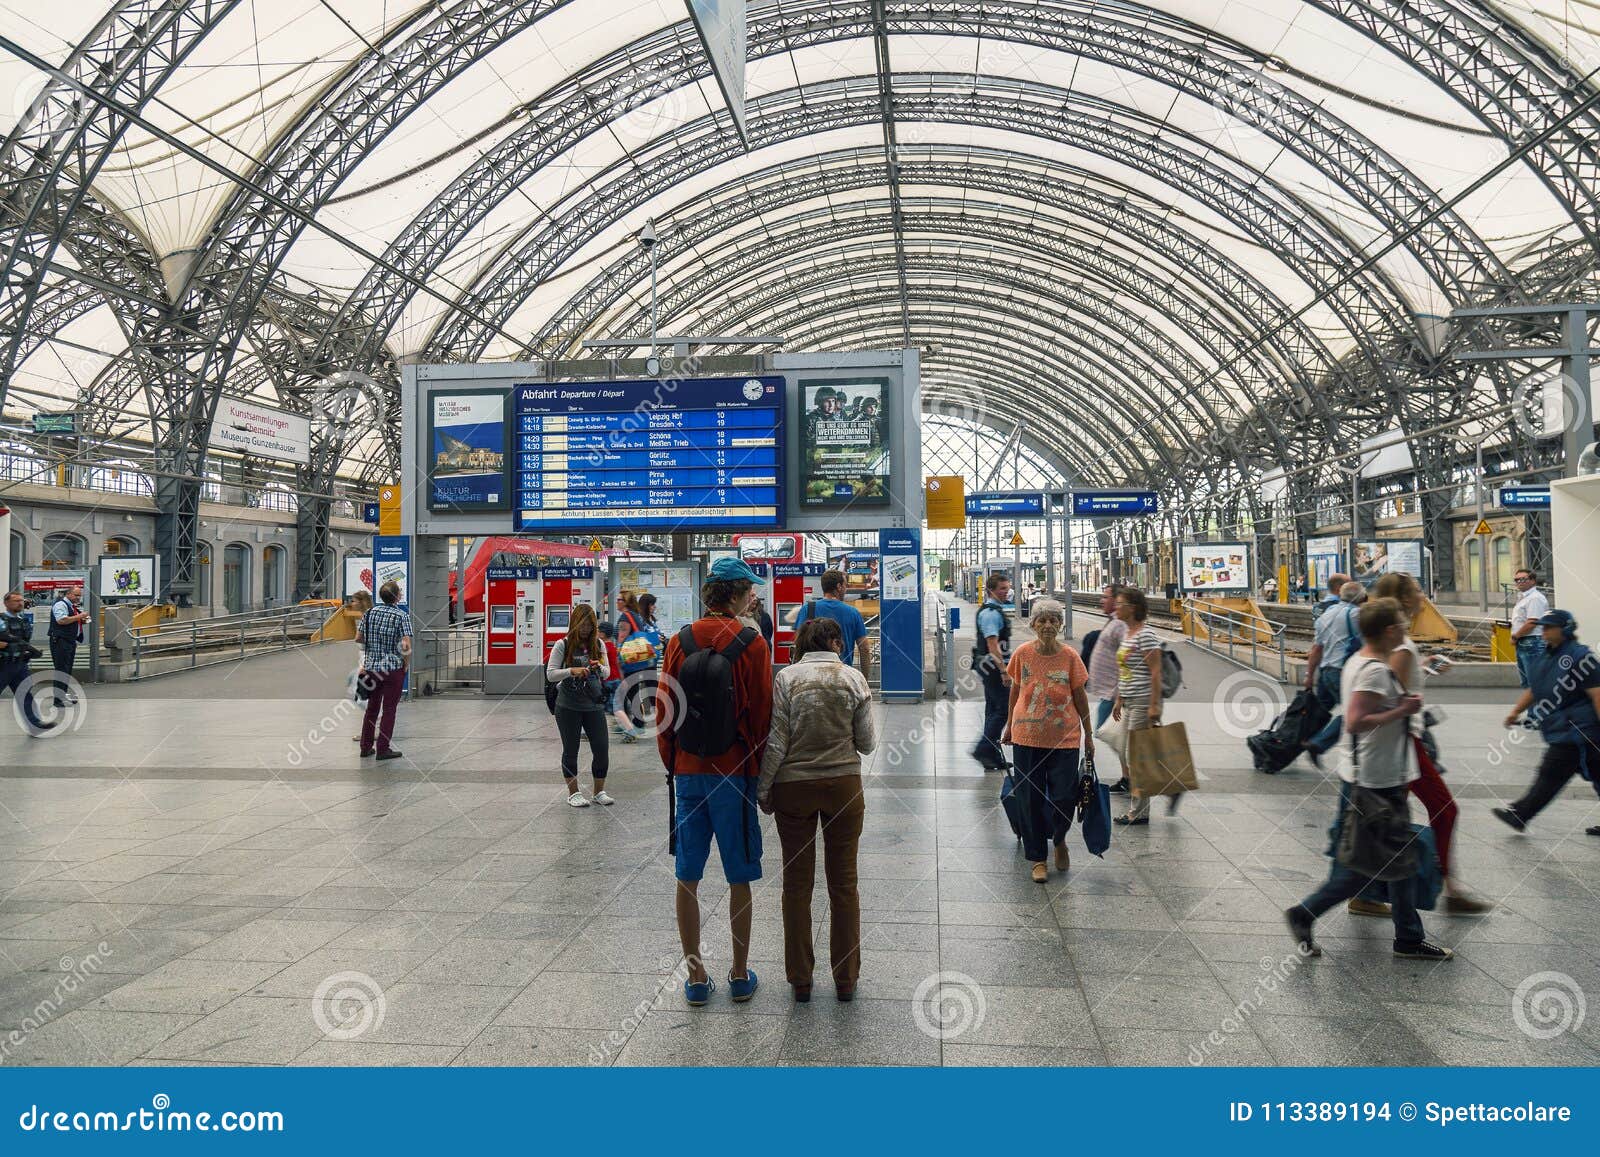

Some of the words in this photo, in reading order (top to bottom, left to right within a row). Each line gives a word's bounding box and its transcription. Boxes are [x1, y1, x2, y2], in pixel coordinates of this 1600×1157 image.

[522, 389, 557, 399] Abfahrt
[560, 390, 596, 400] Departure
[229, 405, 289, 430] Kunstsammlungen
[523, 416, 540, 424] 14:17
[649, 413, 669, 421] Leipzig
[672, 412, 682, 420] Hbf
[245, 423, 276, 438] Chemnitz
[818, 428, 868, 436] WEITERKOMMEN
[649, 432, 671, 440] Schöna
[220, 429, 251, 444] Museum
[251, 436, 296, 453] Gunzenhauser
[674, 439, 689, 447] Trieb
[437, 487, 469, 495] KULTUR
[1504, 492, 1513, 501] 13
[967, 500, 976, 509] 11
[1143, 498, 1153, 507] 12
[369, 508, 375, 516] 9
